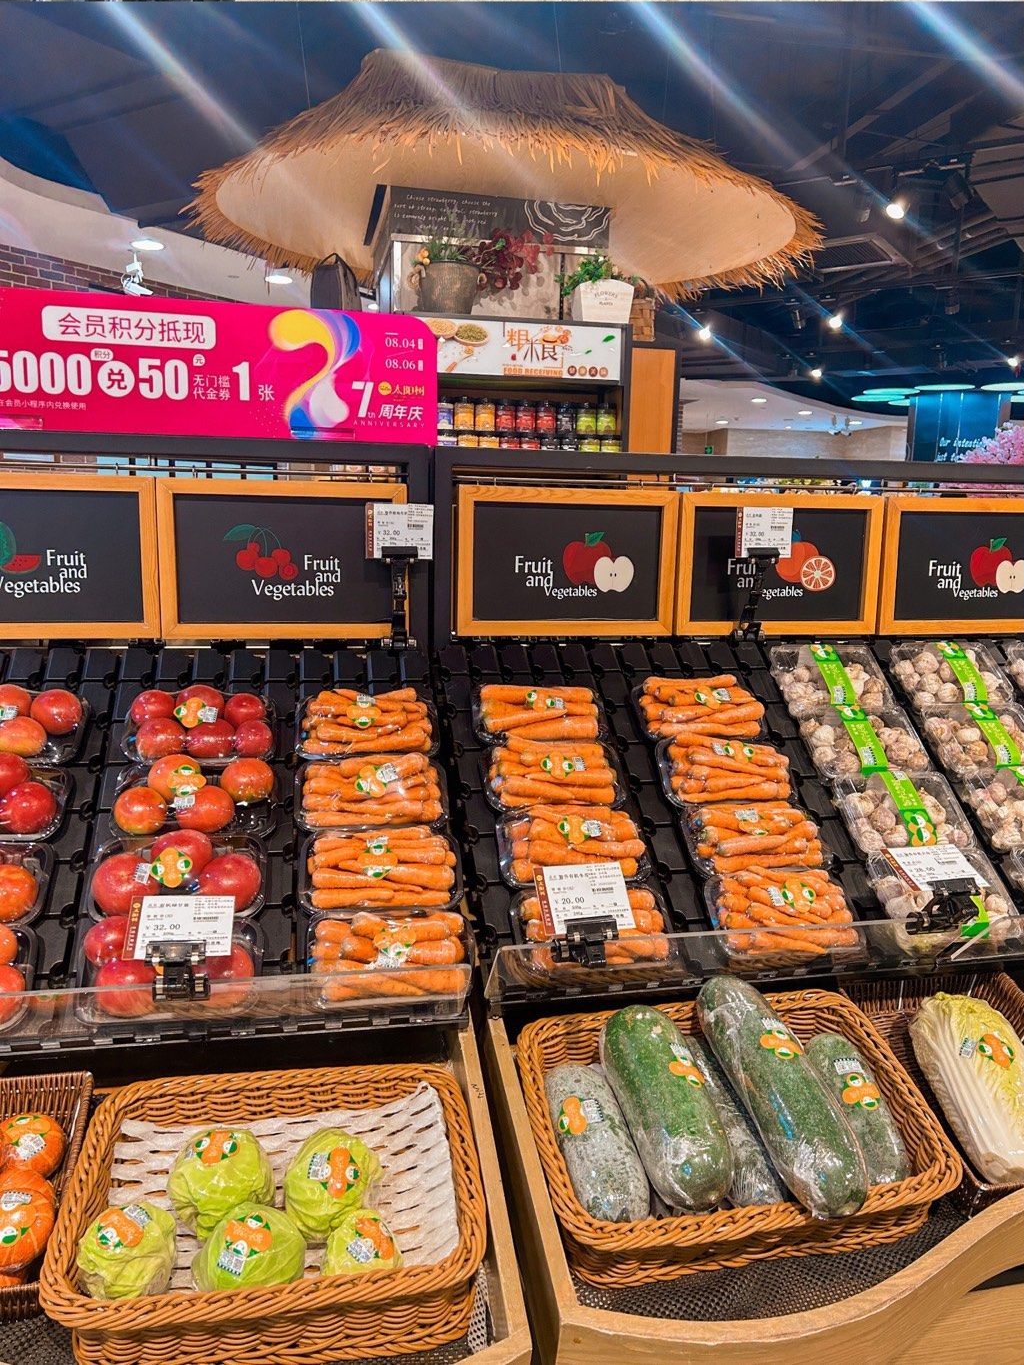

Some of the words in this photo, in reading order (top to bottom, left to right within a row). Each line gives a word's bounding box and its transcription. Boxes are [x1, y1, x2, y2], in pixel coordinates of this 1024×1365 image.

[58, 313, 206, 344] 会员积分抵现
[385, 338, 416, 349] 08.04
[385, 359, 417, 370] 08.06
[106, 367, 128, 390] 兑
[139, 358, 189, 400] 50
[232, 361, 250, 401] 1
[258, 385, 275, 402] 张
[193, 374, 231, 388] 无门槛
[193, 387, 231, 401] 代金券
[353, 419, 426, 429] ANNIVERSARY
[46, 549, 86, 566] Fruit
[304, 554, 341, 572] Fruit
[515, 555, 553, 573] Fruit
[59, 564, 88, 579] and
[727, 558, 757, 575] Frui
[928, 559, 962, 577] Fruit
[315, 568, 341, 584] and
[526, 571, 553, 587] and
[737, 577, 754, 588] an
[937, 574, 962, 589] and
[251, 579, 335, 601] Vegetables
[544, 585, 598, 600] Vegetables
[762, 586, 803, 600] egetables
[952, 587, 998, 601] Vegetables
[562, 897, 585, 905] 20.00
[153, 923, 181, 932] 32.00
